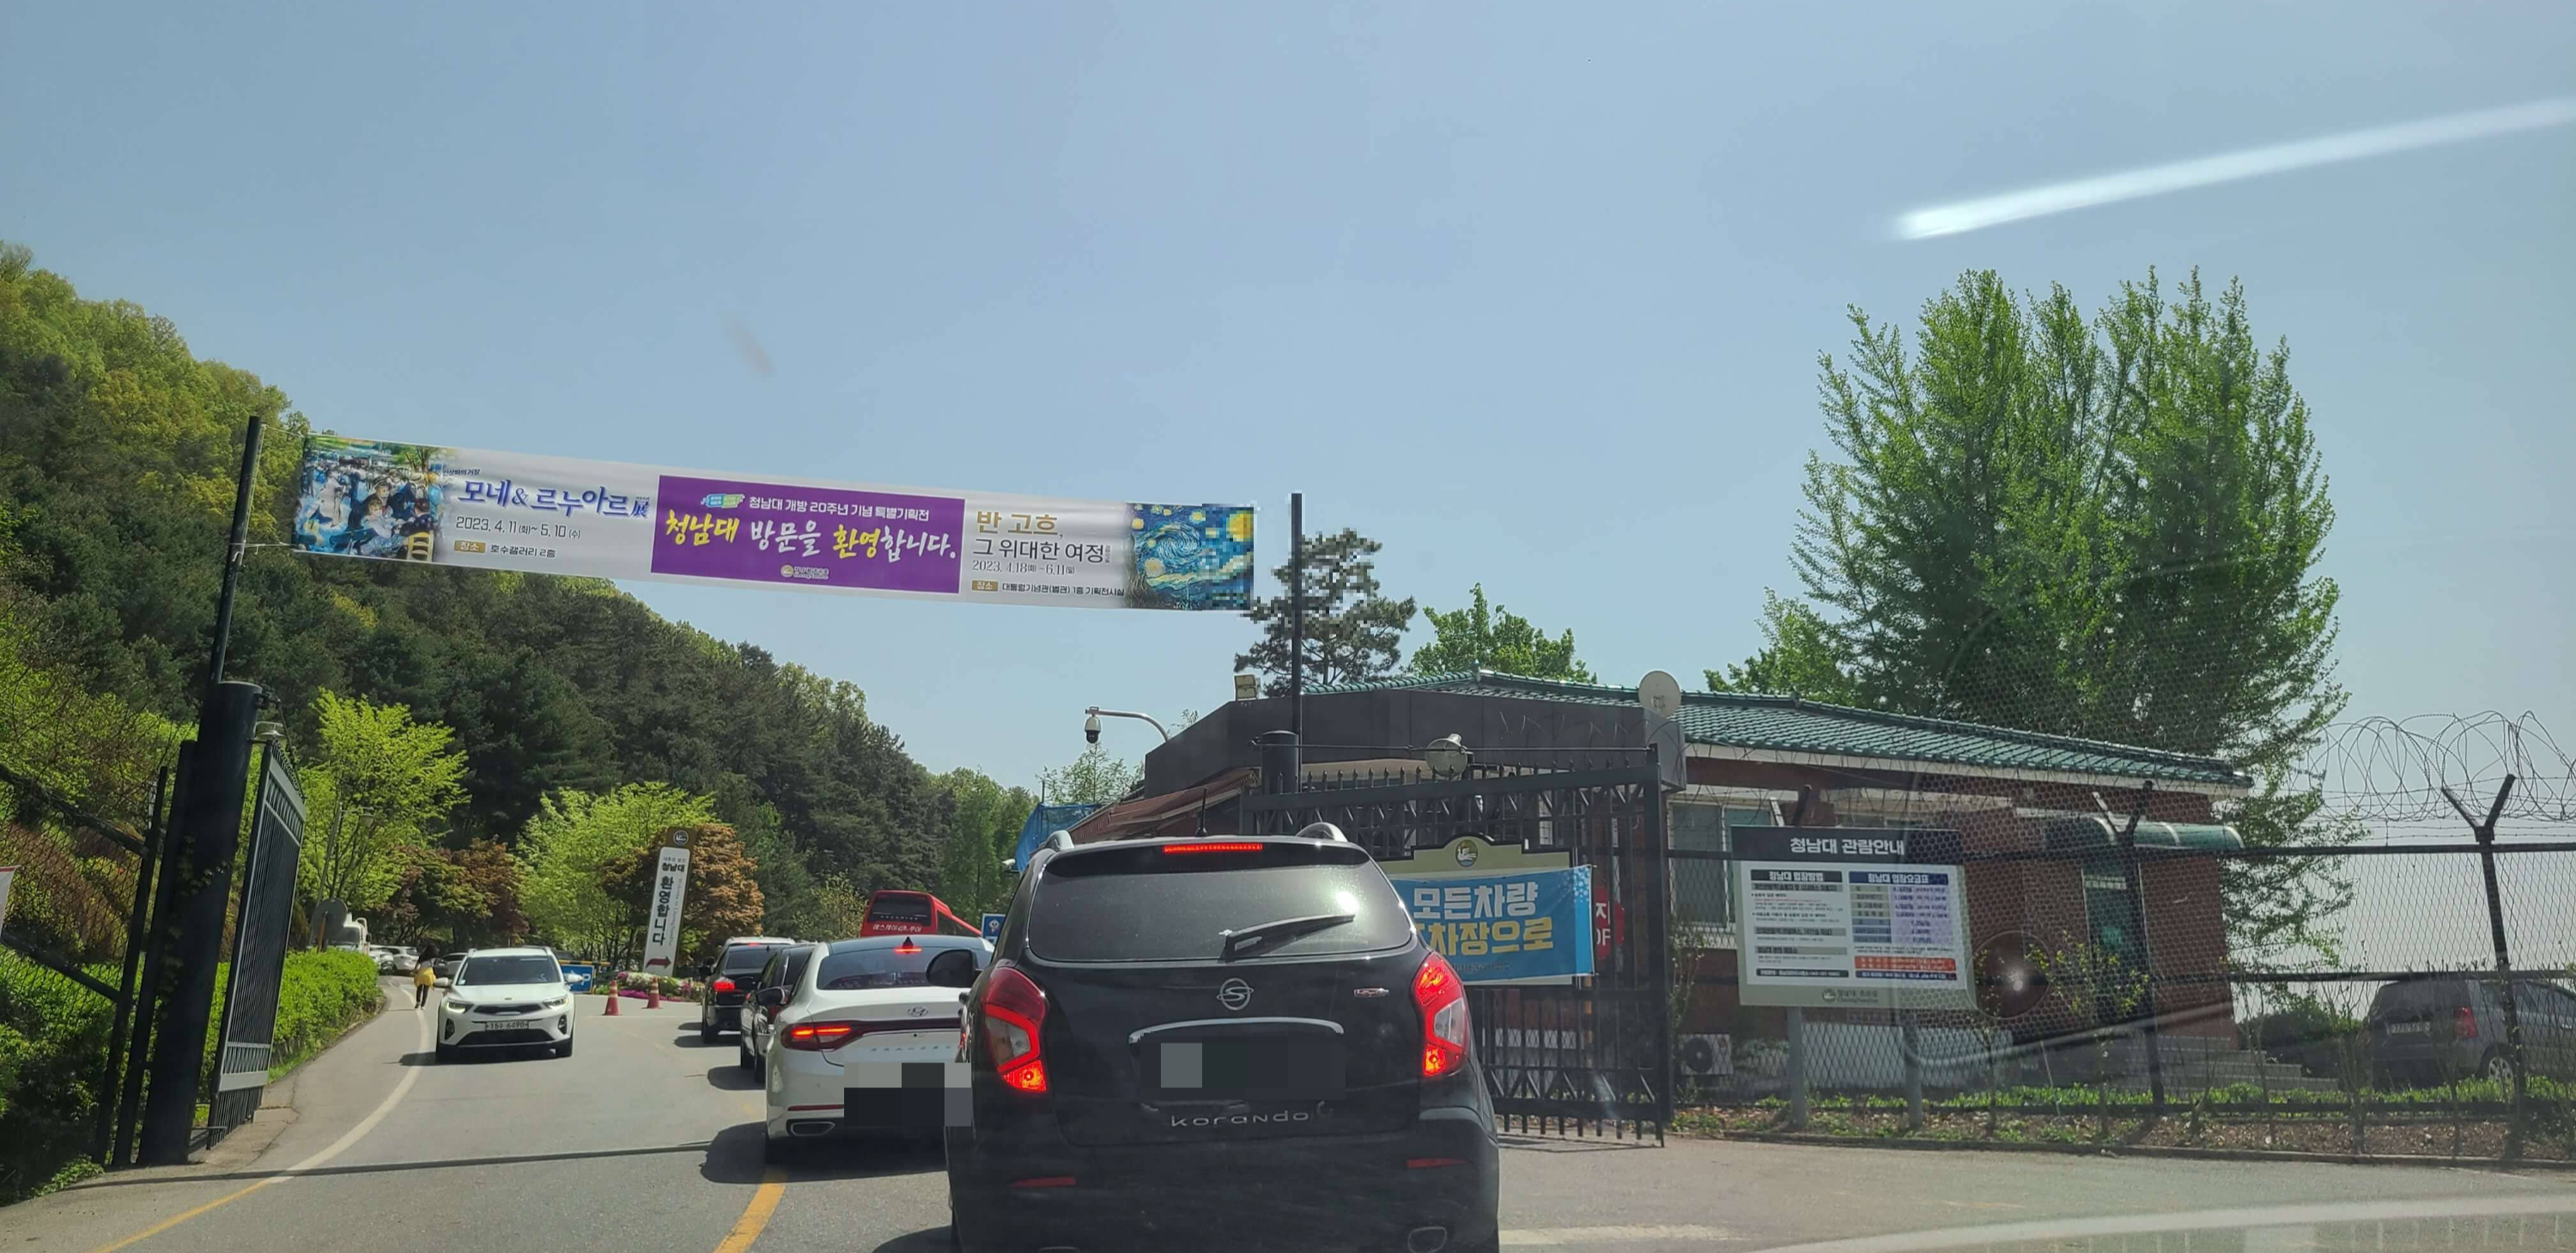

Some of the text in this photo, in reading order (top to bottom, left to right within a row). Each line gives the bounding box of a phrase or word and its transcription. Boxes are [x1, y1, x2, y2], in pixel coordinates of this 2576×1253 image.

[749, 496, 783, 511] 청남대
[785, 498, 808, 513] 개방
[810, 501, 848, 516] 20주년
[851, 503, 872, 518] 기념
[875, 506, 929, 522] 특별기획전
[456, 515, 491, 532] 2023.
[976, 510, 1064, 540] 반 고흐,
[459, 541, 480, 551] 장소
[665, 509, 957, 563] 청남대 방문을 환영합니다.
[490, 544, 556, 558] 호수갤러리 2층
[973, 538, 993, 556] 그
[999, 539, 1060, 561] 위대한
[1065, 543, 1104, 563] 여정
[972, 559, 1003, 573] 2023.
[976, 581, 994, 590] 장소
[1085, 587, 1125, 597] 기획전시실
[1789, 836, 1905, 857] 청남대 관람안내
[653, 875, 675, 946] 환영합니다
[1413, 881, 1539, 920] 모든차량
[1595, 900, 1611, 925] 지
